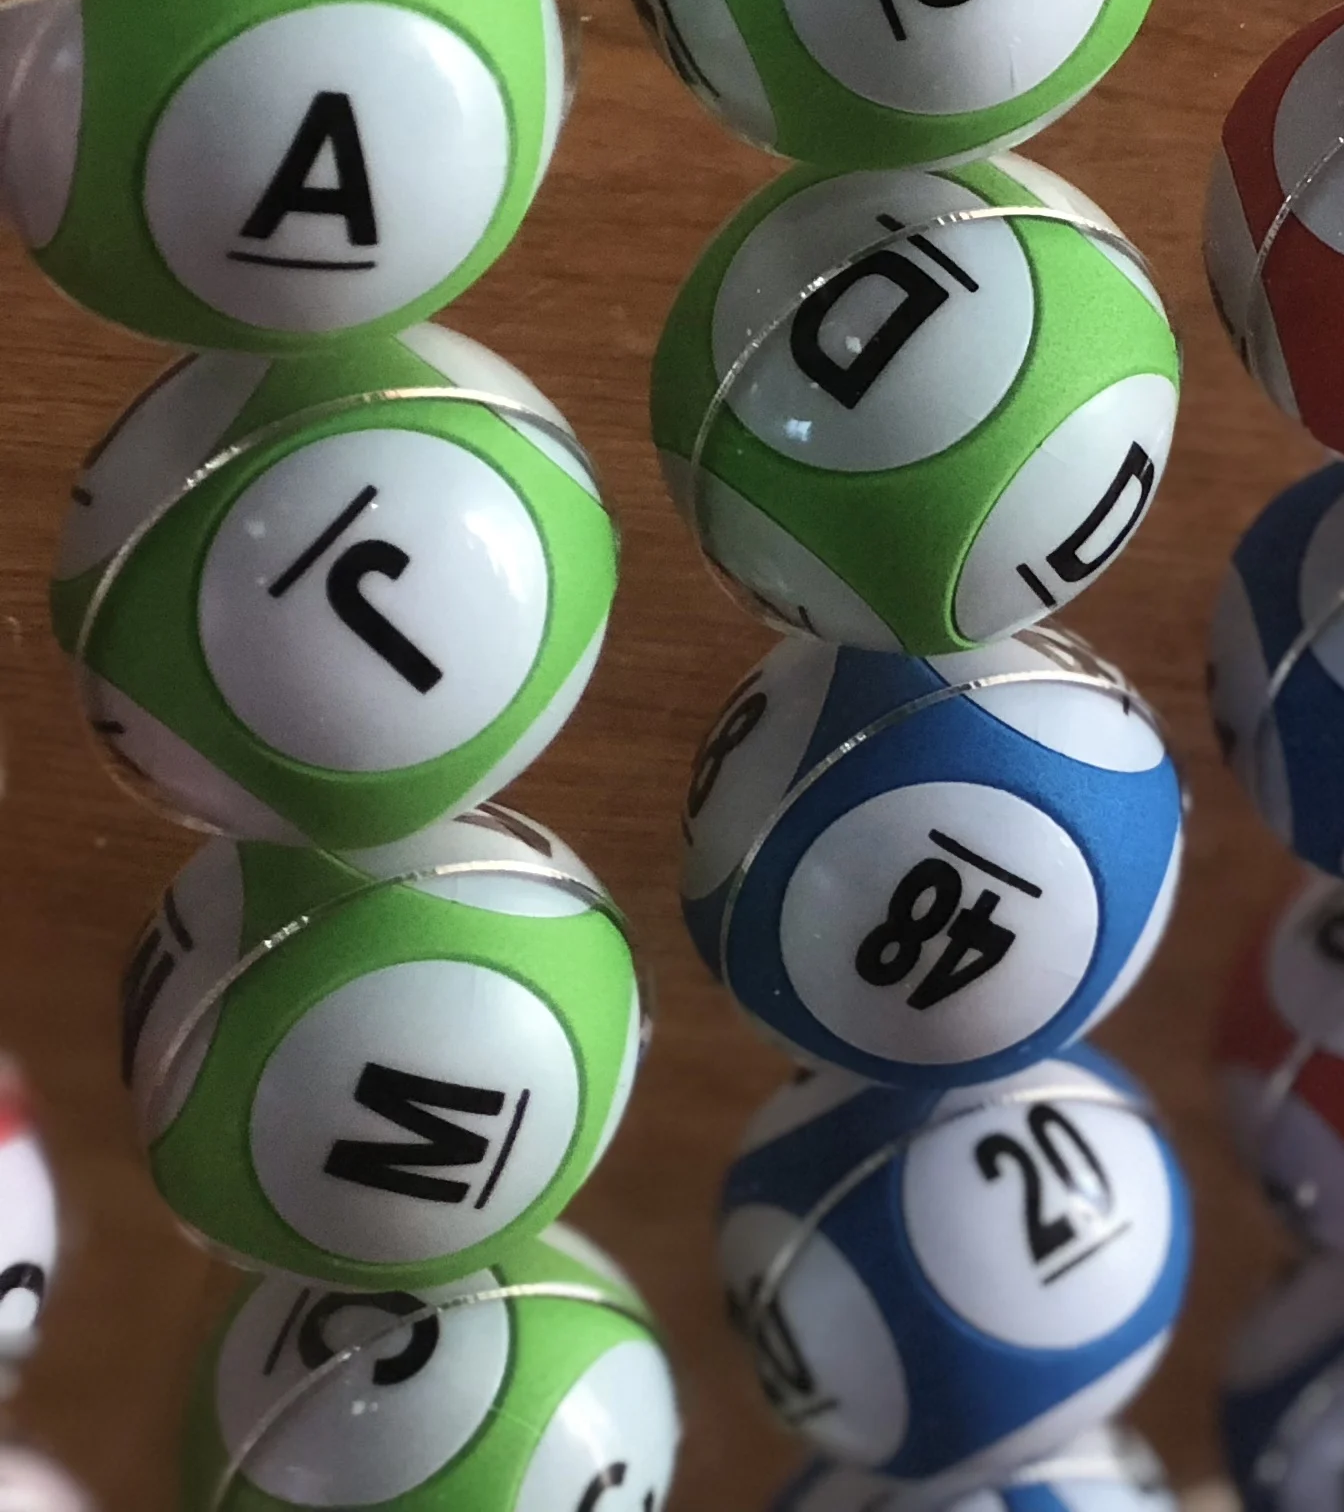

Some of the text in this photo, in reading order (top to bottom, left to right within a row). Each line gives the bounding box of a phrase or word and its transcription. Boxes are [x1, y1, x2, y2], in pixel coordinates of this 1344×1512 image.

[240, 91, 379, 246] A
[790, 249, 950, 410] D
[1045, 440, 1156, 584] D
[312, 525, 443, 695] J
[853, 856, 1020, 1012] 48
[322, 1061, 506, 1204] M
[974, 1101, 1113, 1266] 20
